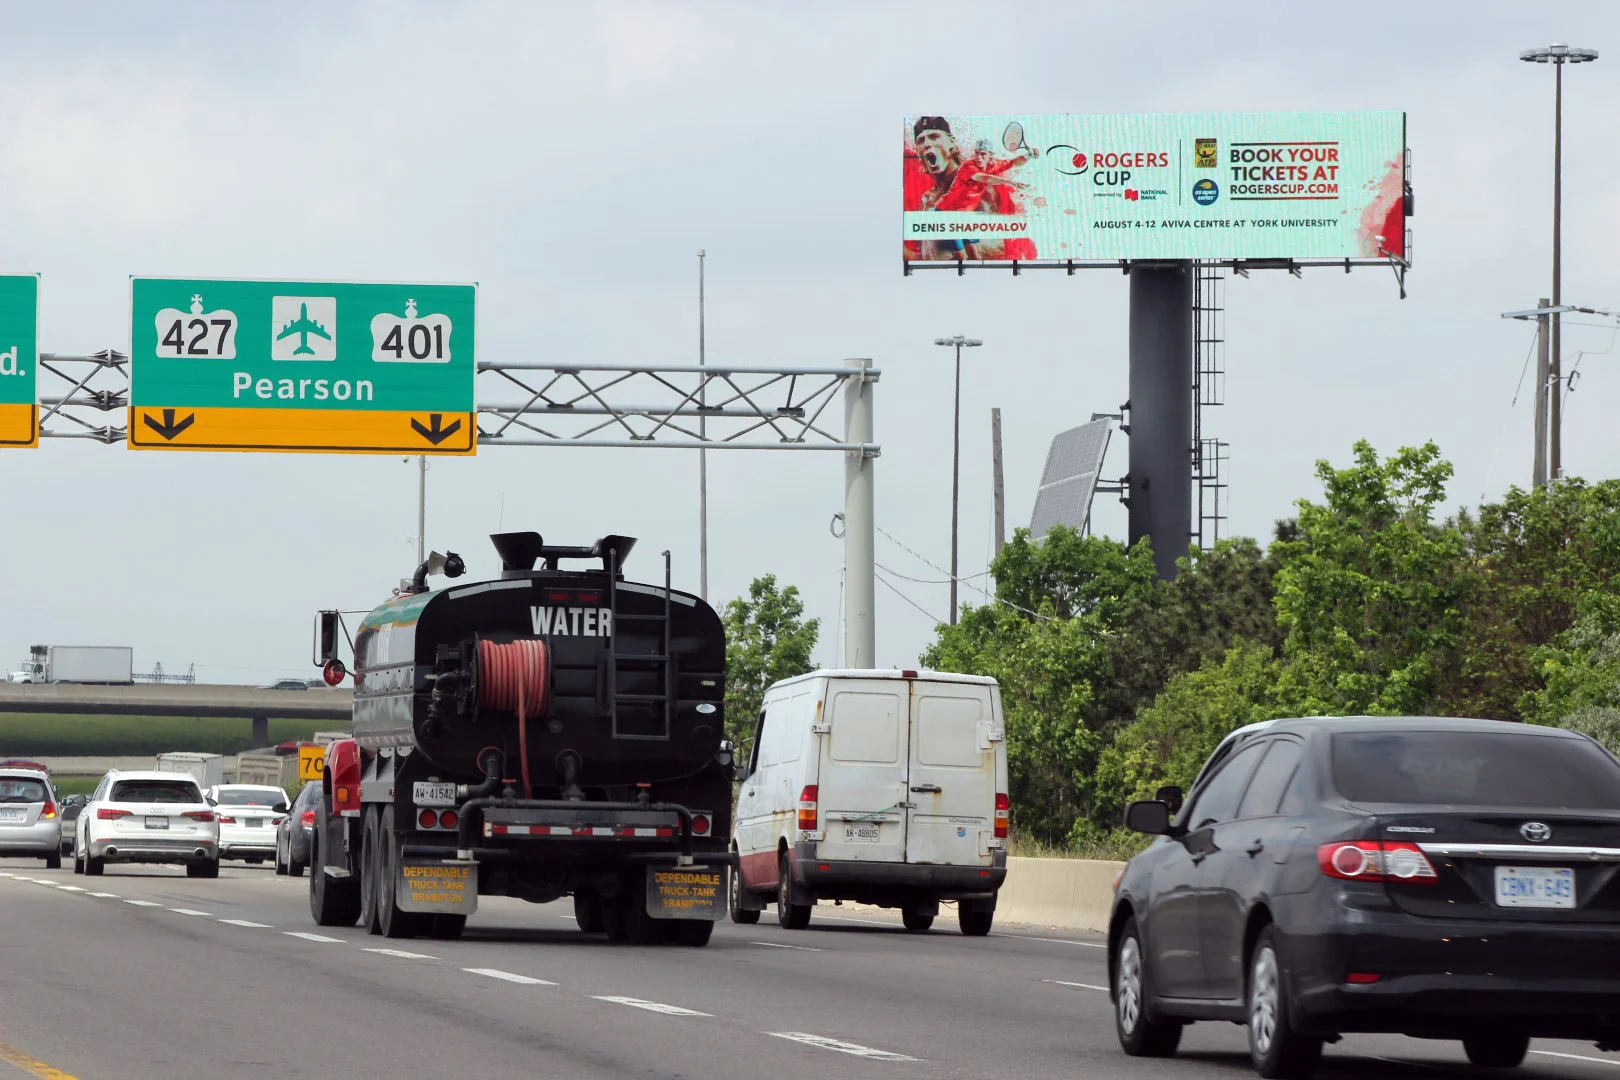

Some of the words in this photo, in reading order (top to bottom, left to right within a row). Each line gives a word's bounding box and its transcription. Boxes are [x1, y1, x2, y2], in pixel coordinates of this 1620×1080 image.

[1093, 152, 1169, 168] ROGERS
[1230, 148, 1284, 163] BOOK
[1287, 147, 1339, 163] YOUR
[1093, 171, 1131, 186] CUP
[1230, 165, 1309, 181] TICKETS
[1313, 165, 1339, 181] AT
[1230, 183, 1338, 195] ROGERSCUP.COM
[912, 223, 946, 232] DENIS
[948, 222, 1027, 232] SHAPOVALOV
[1093, 220, 1133, 229] AUGUST
[1134, 220, 1156, 229] 4-12
[1161, 220, 1191, 228] AVIVA
[1193, 219, 1231, 228] CENTRE
[1233, 219, 1246, 228] AT
[1251, 219, 1278, 228] YORK
[1280, 219, 1338, 228] UNIVERSITY
[161, 319, 232, 356] 427
[380, 324, 445, 360] 401
[233, 371, 374, 401] Pearson
[529, 605, 612, 637] WATER
[301, 757, 324, 773] 70
[403, 866, 470, 878] DEPENDABLE
[655, 872, 721, 885] DEPENDABLE
[407, 880, 465, 891] TRUCK-TANK
[658, 886, 716, 897] TRUCK-TANK
[411, 892, 464, 904] BRAMPTON
